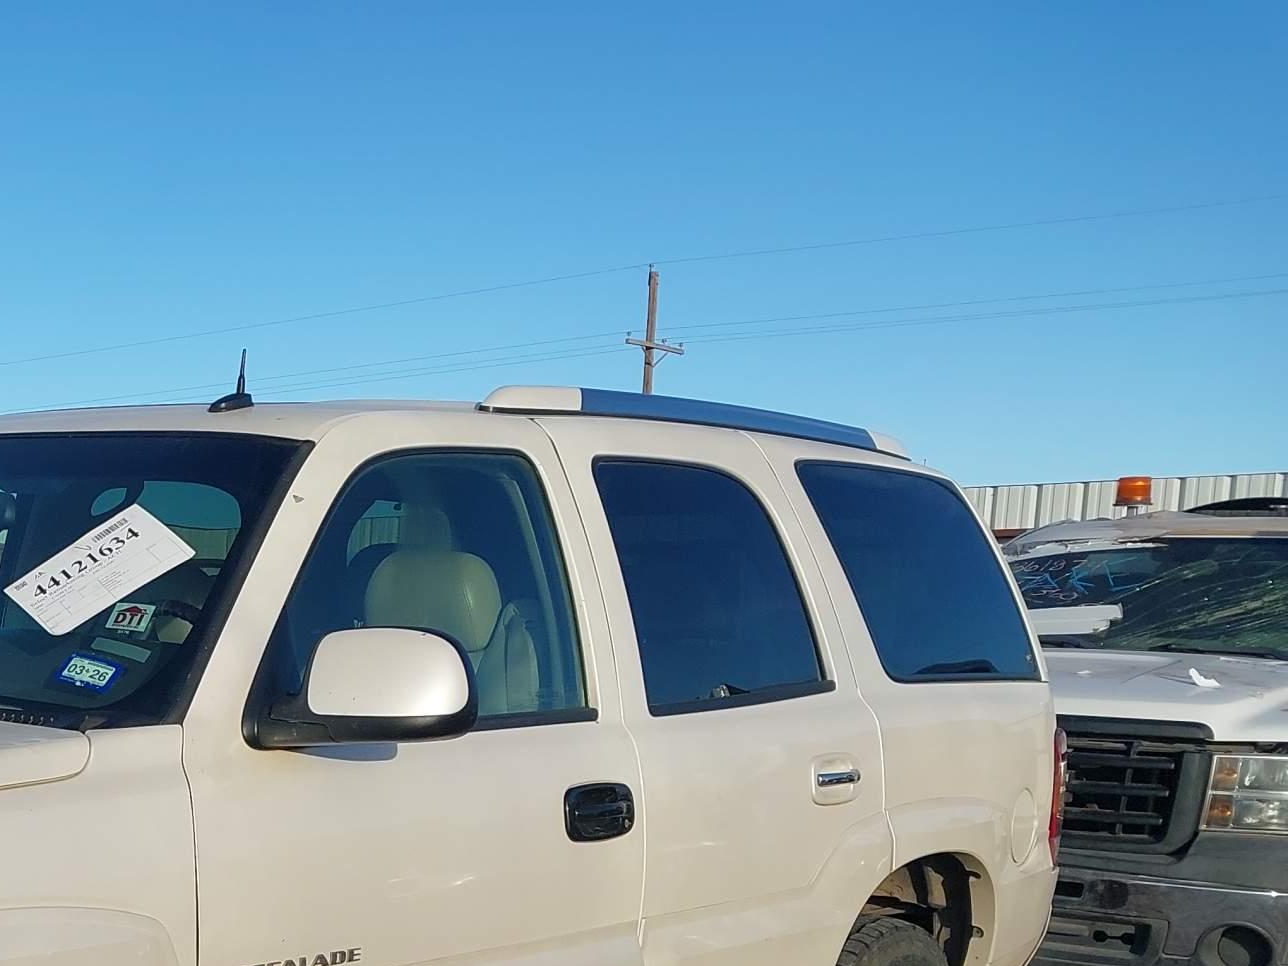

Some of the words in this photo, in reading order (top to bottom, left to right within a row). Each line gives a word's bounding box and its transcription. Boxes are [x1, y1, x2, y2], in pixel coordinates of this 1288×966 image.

[34, 527, 140, 597] 44121634
[113, 612, 145, 626] DTI
[67, 663, 85, 675] 03
[88, 669, 109, 681] 26
